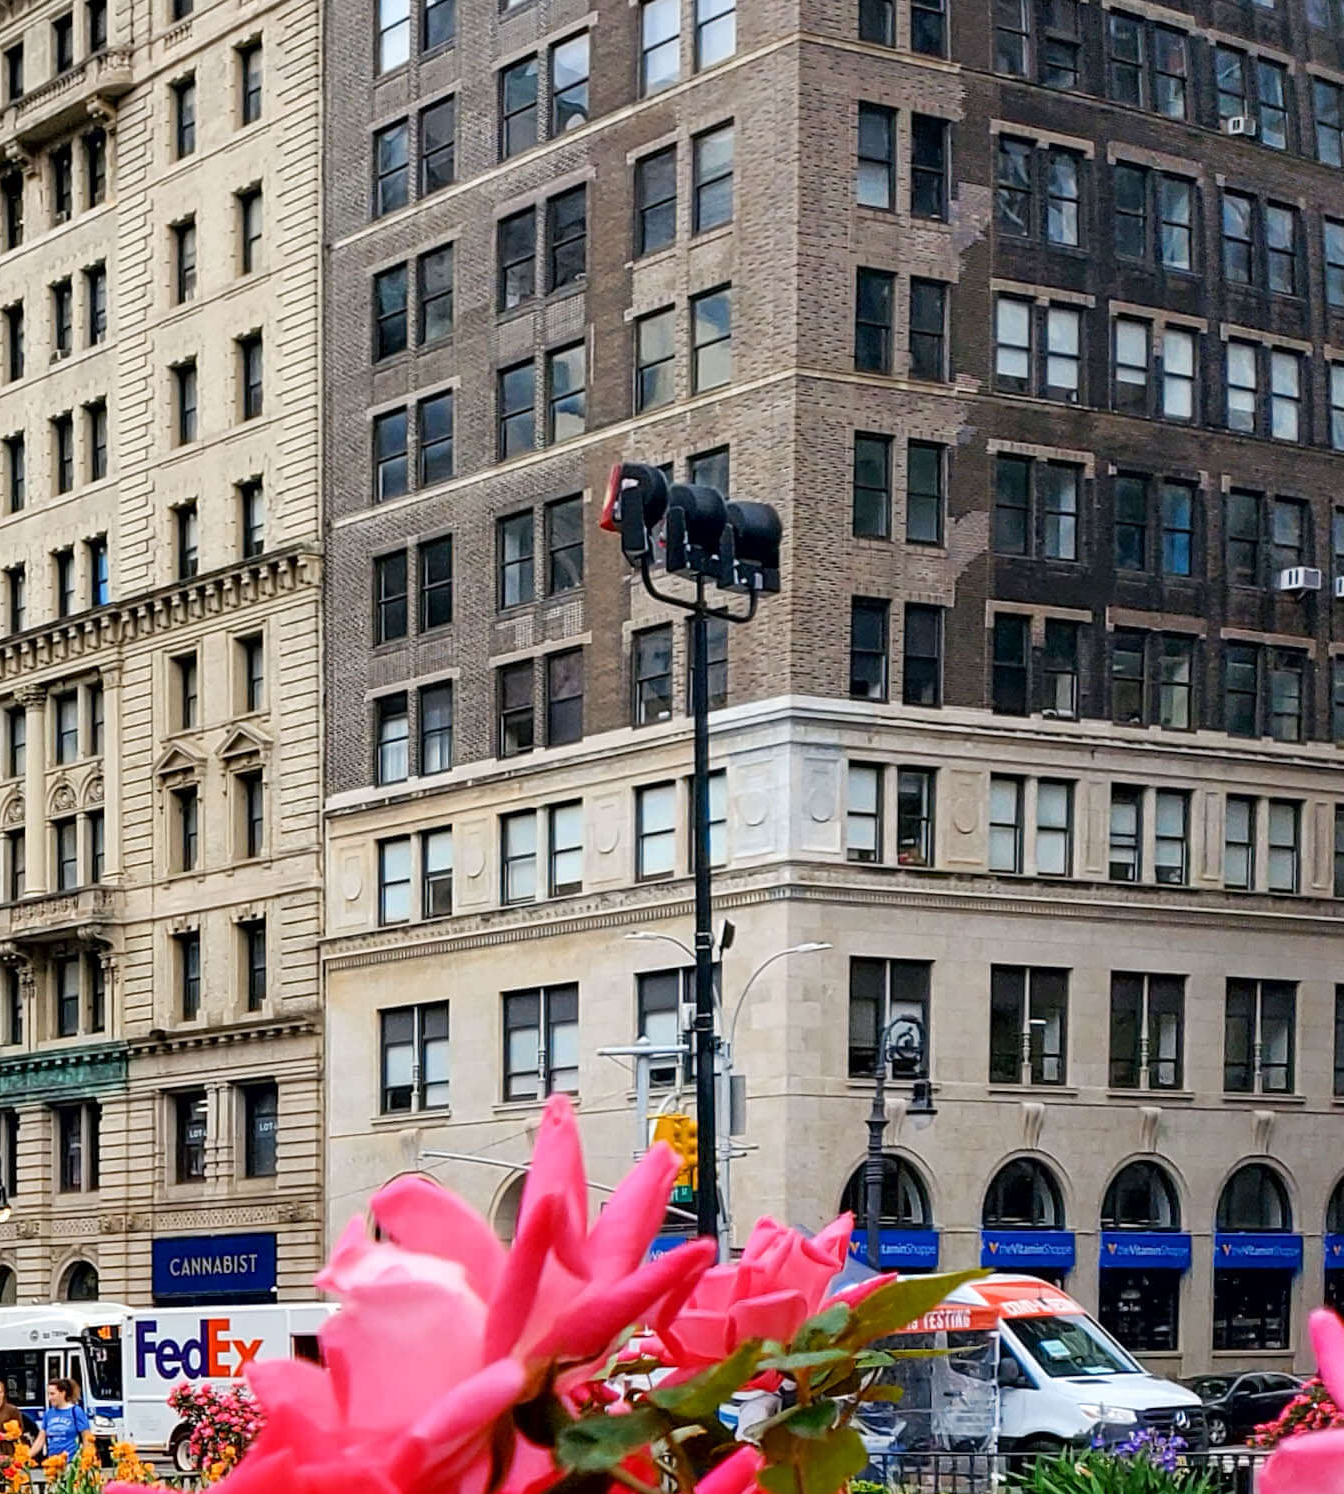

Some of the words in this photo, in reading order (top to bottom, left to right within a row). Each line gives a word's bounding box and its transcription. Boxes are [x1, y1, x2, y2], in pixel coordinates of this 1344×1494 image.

[169, 1254, 258, 1277] CANNABIST
[924, 1309, 971, 1329] TESTING
[135, 1318, 264, 1380] FedEx
